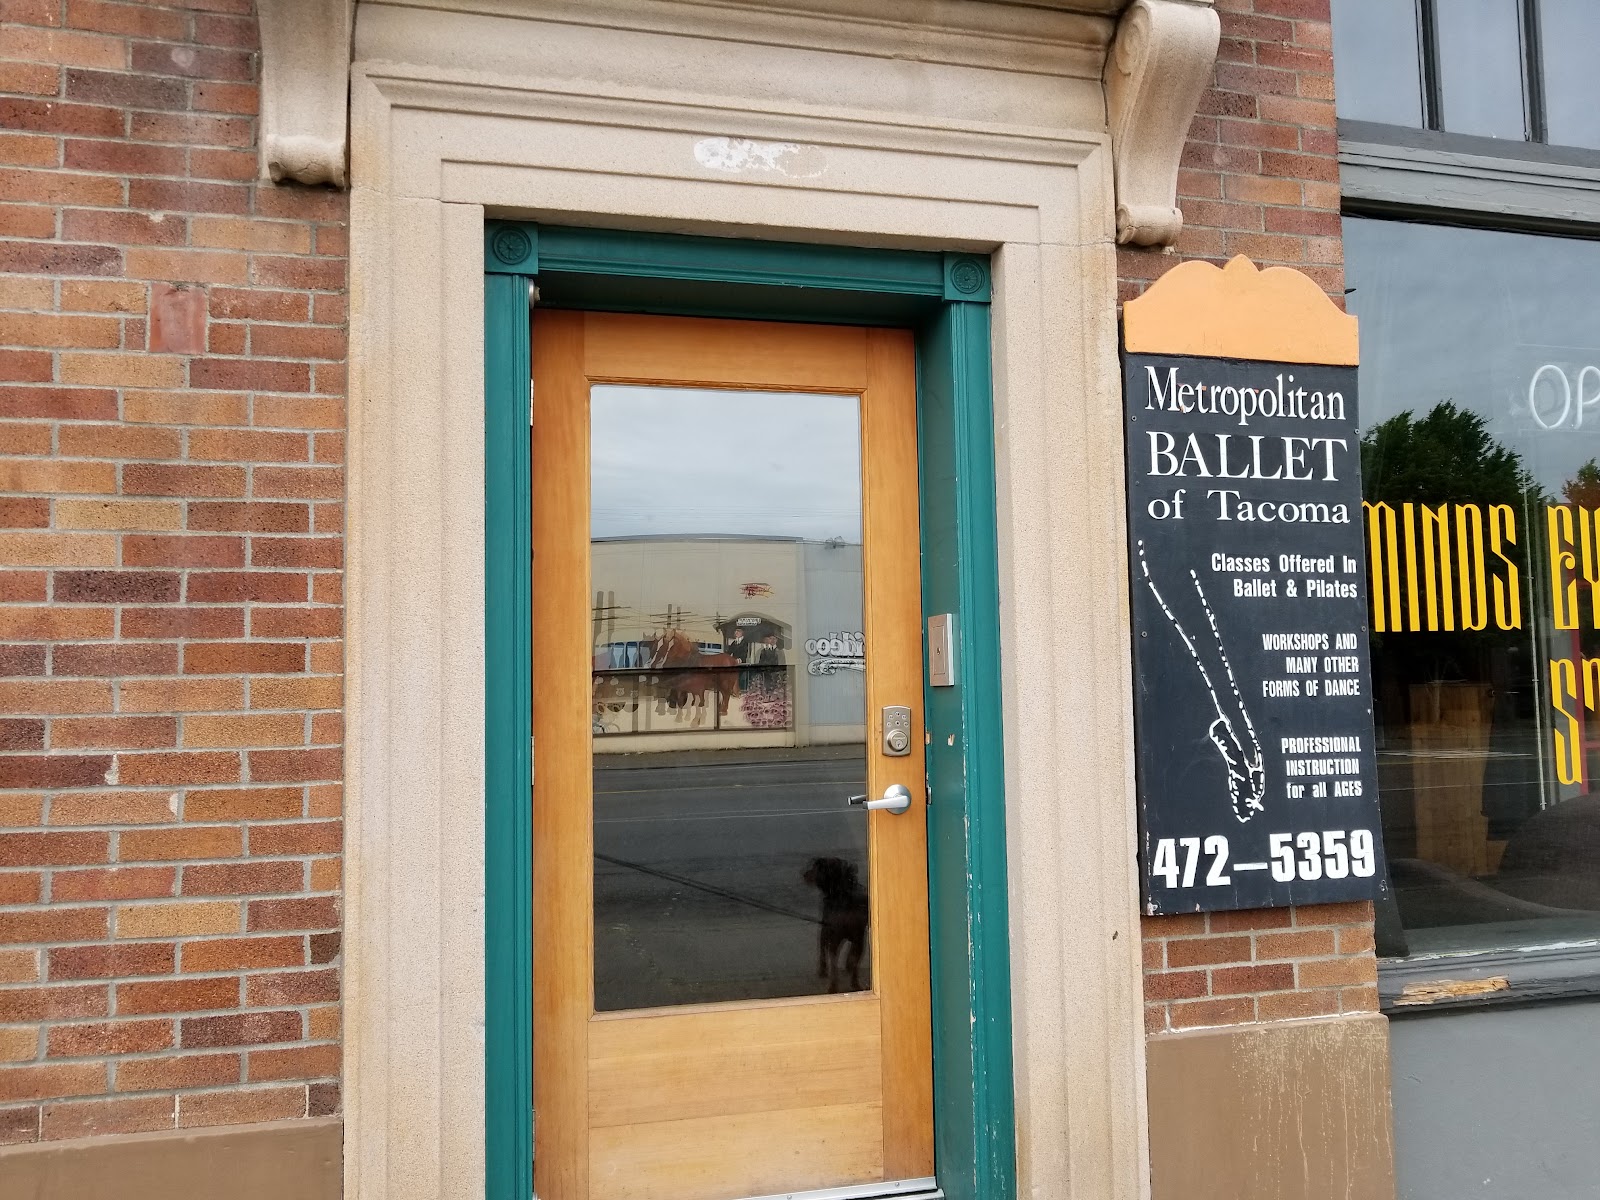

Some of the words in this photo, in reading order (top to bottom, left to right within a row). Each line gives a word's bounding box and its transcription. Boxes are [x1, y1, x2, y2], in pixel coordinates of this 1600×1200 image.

[1144, 366, 1346, 425] Metropolitan
[1146, 431, 1347, 481] BALLET
[1148, 489, 1186, 519] of
[1207, 490, 1350, 523] Tacoma
[1212, 553, 1270, 572] Classes
[1279, 554, 1334, 573] Offered
[1343, 555, 1356, 573] In
[1234, 579, 1276, 597] Ballet
[1286, 579, 1297, 597] &
[1307, 580, 1357, 598] Pilates
[1262, 633, 1329, 650] WORKSHOPS
[1336, 633, 1357, 649] AND
[1286, 655, 1317, 673] MANY
[1324, 656, 1359, 673] OTHER
[1263, 680, 1299, 697] FORMS
[1306, 680, 1318, 696] OF
[1325, 679, 1360, 696] DANCE
[1281, 736, 1361, 753] PROFESSIONAL
[1286, 758, 1359, 776] INSTRUCTION
[1286, 782, 1305, 798] for
[1313, 782, 1327, 797] all
[1335, 781, 1362, 797] AGES
[1153, 830, 1375, 888] 472-5359
